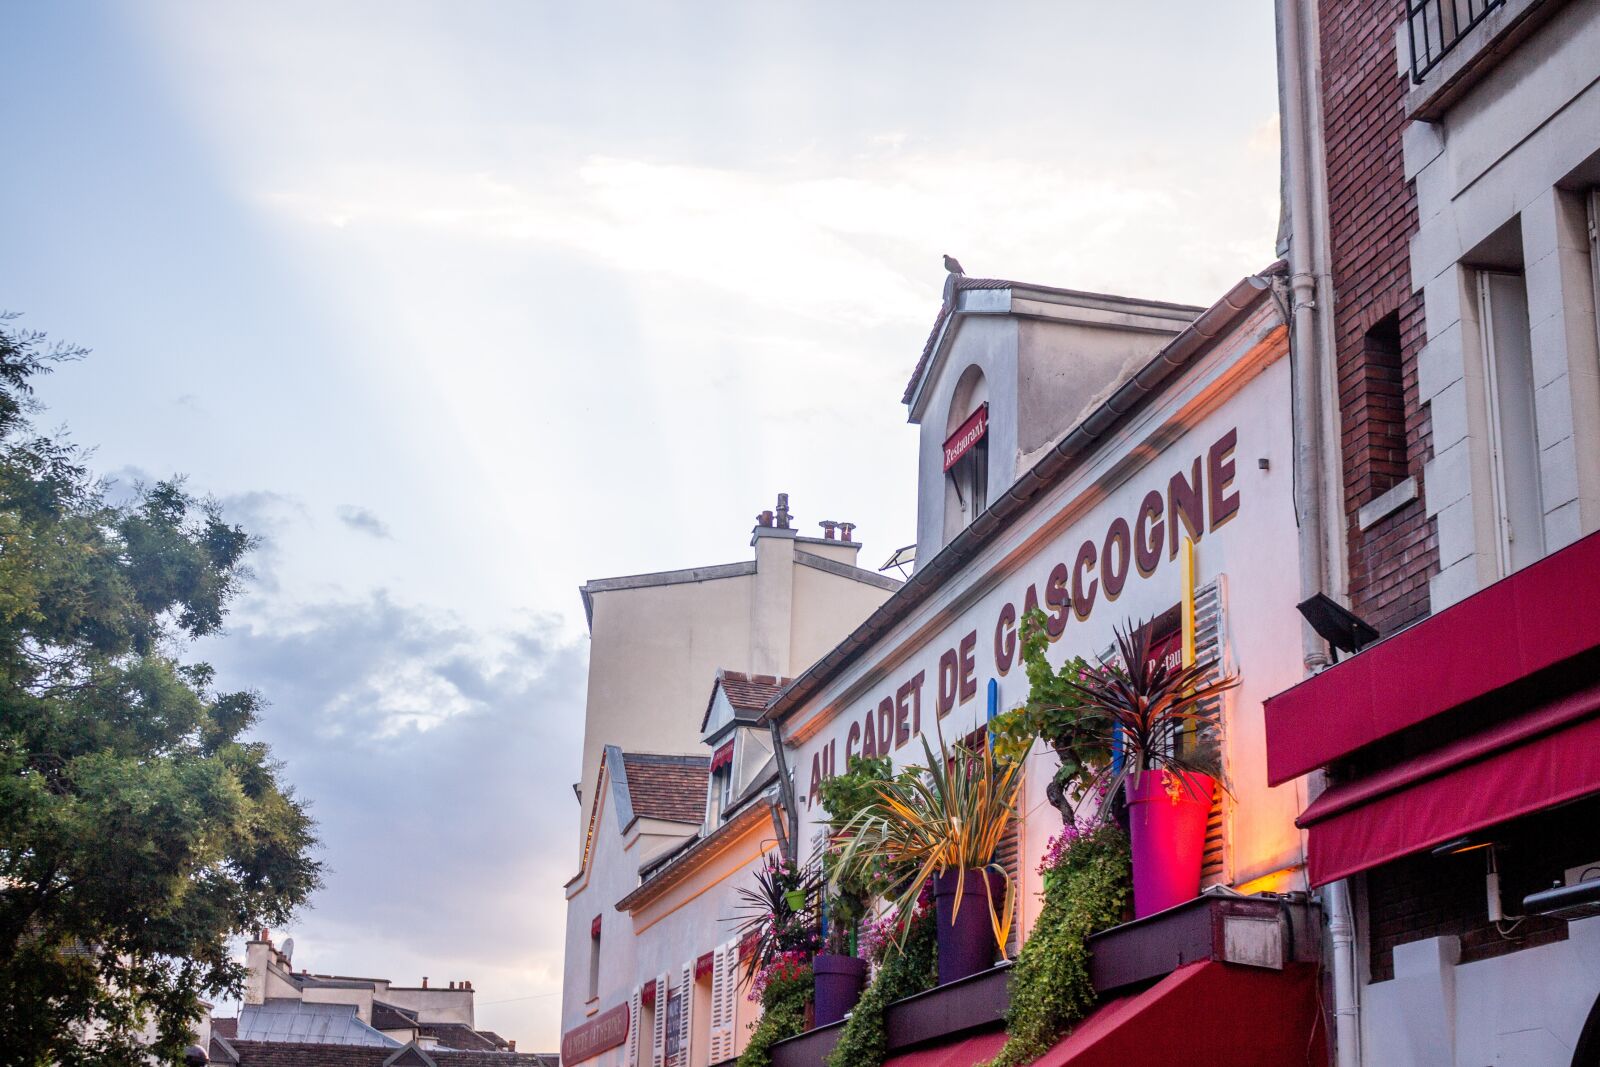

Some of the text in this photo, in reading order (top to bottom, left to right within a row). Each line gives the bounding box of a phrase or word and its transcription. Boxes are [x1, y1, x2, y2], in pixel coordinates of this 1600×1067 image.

[945, 418, 983, 466] Restaurant
[808, 738, 836, 811] AU
[846, 669, 925, 776] CADET
[938, 629, 977, 720] DE
